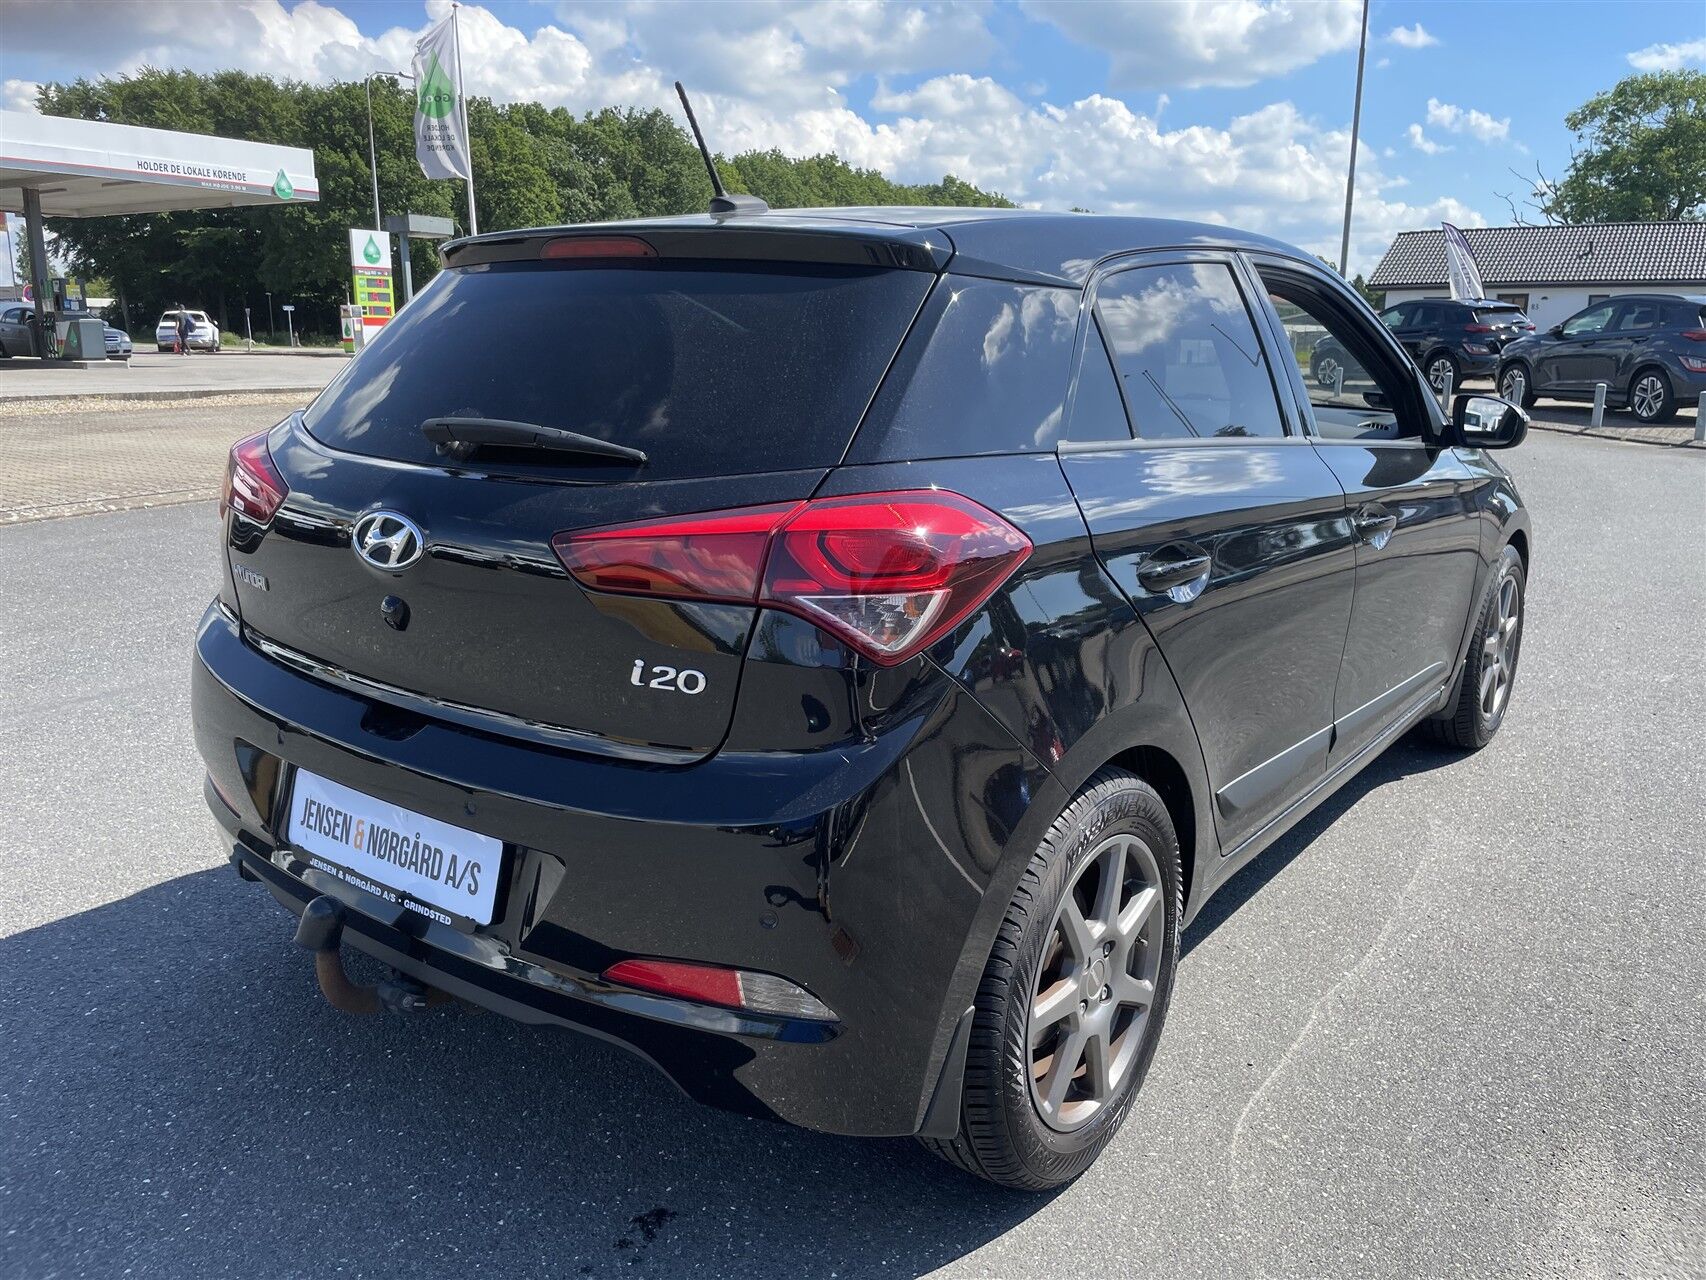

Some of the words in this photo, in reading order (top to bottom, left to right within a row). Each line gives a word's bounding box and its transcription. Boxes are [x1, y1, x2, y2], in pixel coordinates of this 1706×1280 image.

[137, 160, 169, 173] HOLDER
[171, 164, 181, 174] DE
[182, 166, 211, 178] LOKALE
[630, 659, 707, 695] i20
[300, 797, 353, 845] JENSEN
[353, 818, 365, 850] &
[366, 823, 444, 881] NØRGÅRD
[444, 853, 481, 896] A/S
[309, 857, 337, 876] JENSEN
[337, 870, 344, 881] &
[345, 873, 382, 896] NØRGÅRD
[382, 890, 397, 903] A/S
[403, 900, 452, 926] GRINDSTED
